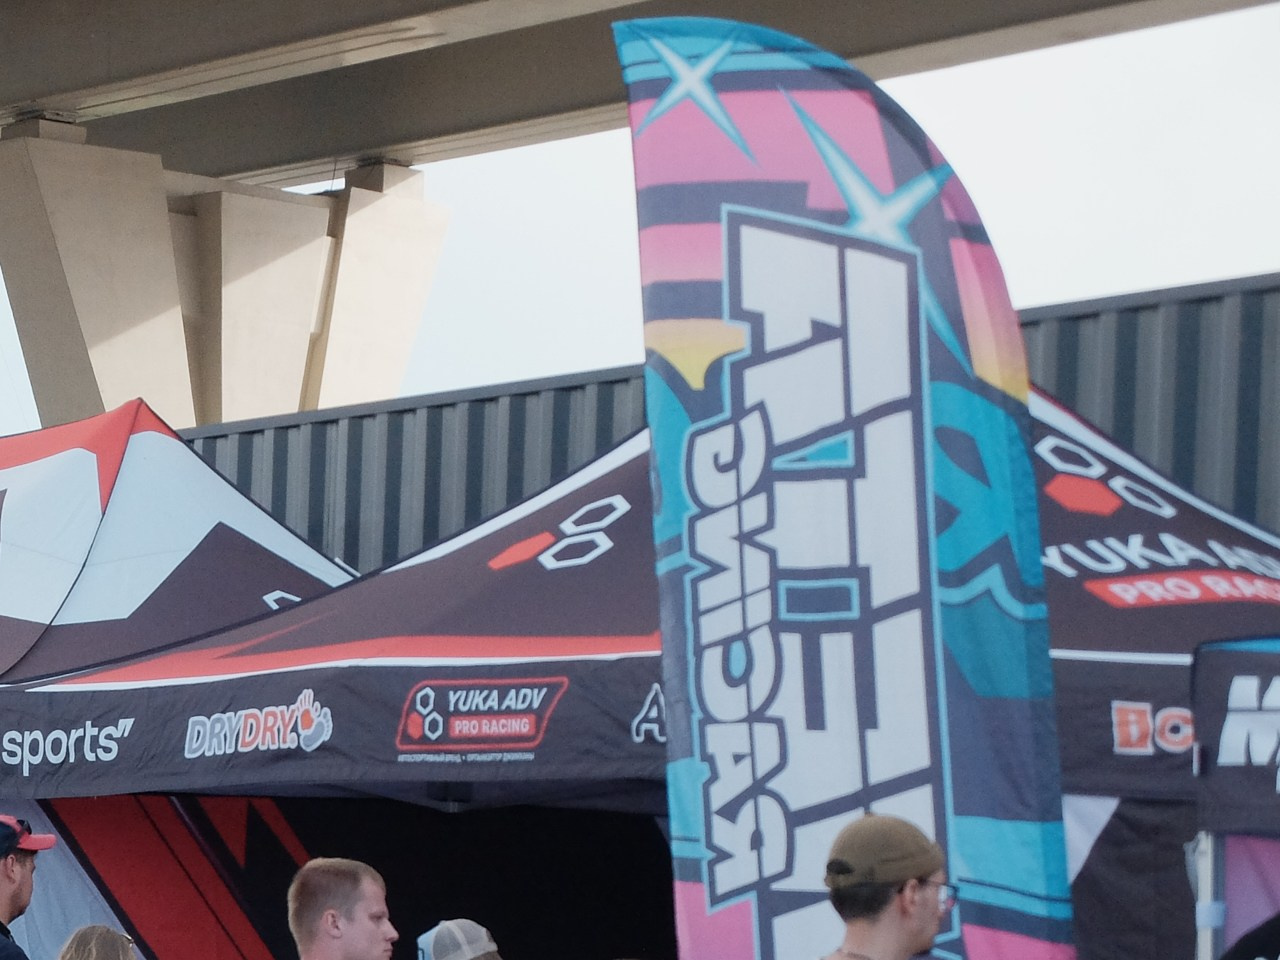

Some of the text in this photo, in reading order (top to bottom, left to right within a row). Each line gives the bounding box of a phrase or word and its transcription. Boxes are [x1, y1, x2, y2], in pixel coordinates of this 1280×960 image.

[1041, 533, 1219, 578] YUKA
[1108, 576, 1201, 604] PRO
[448, 687, 548, 713] YUKA ADV
[454, 717, 530, 735] PRO RACING
